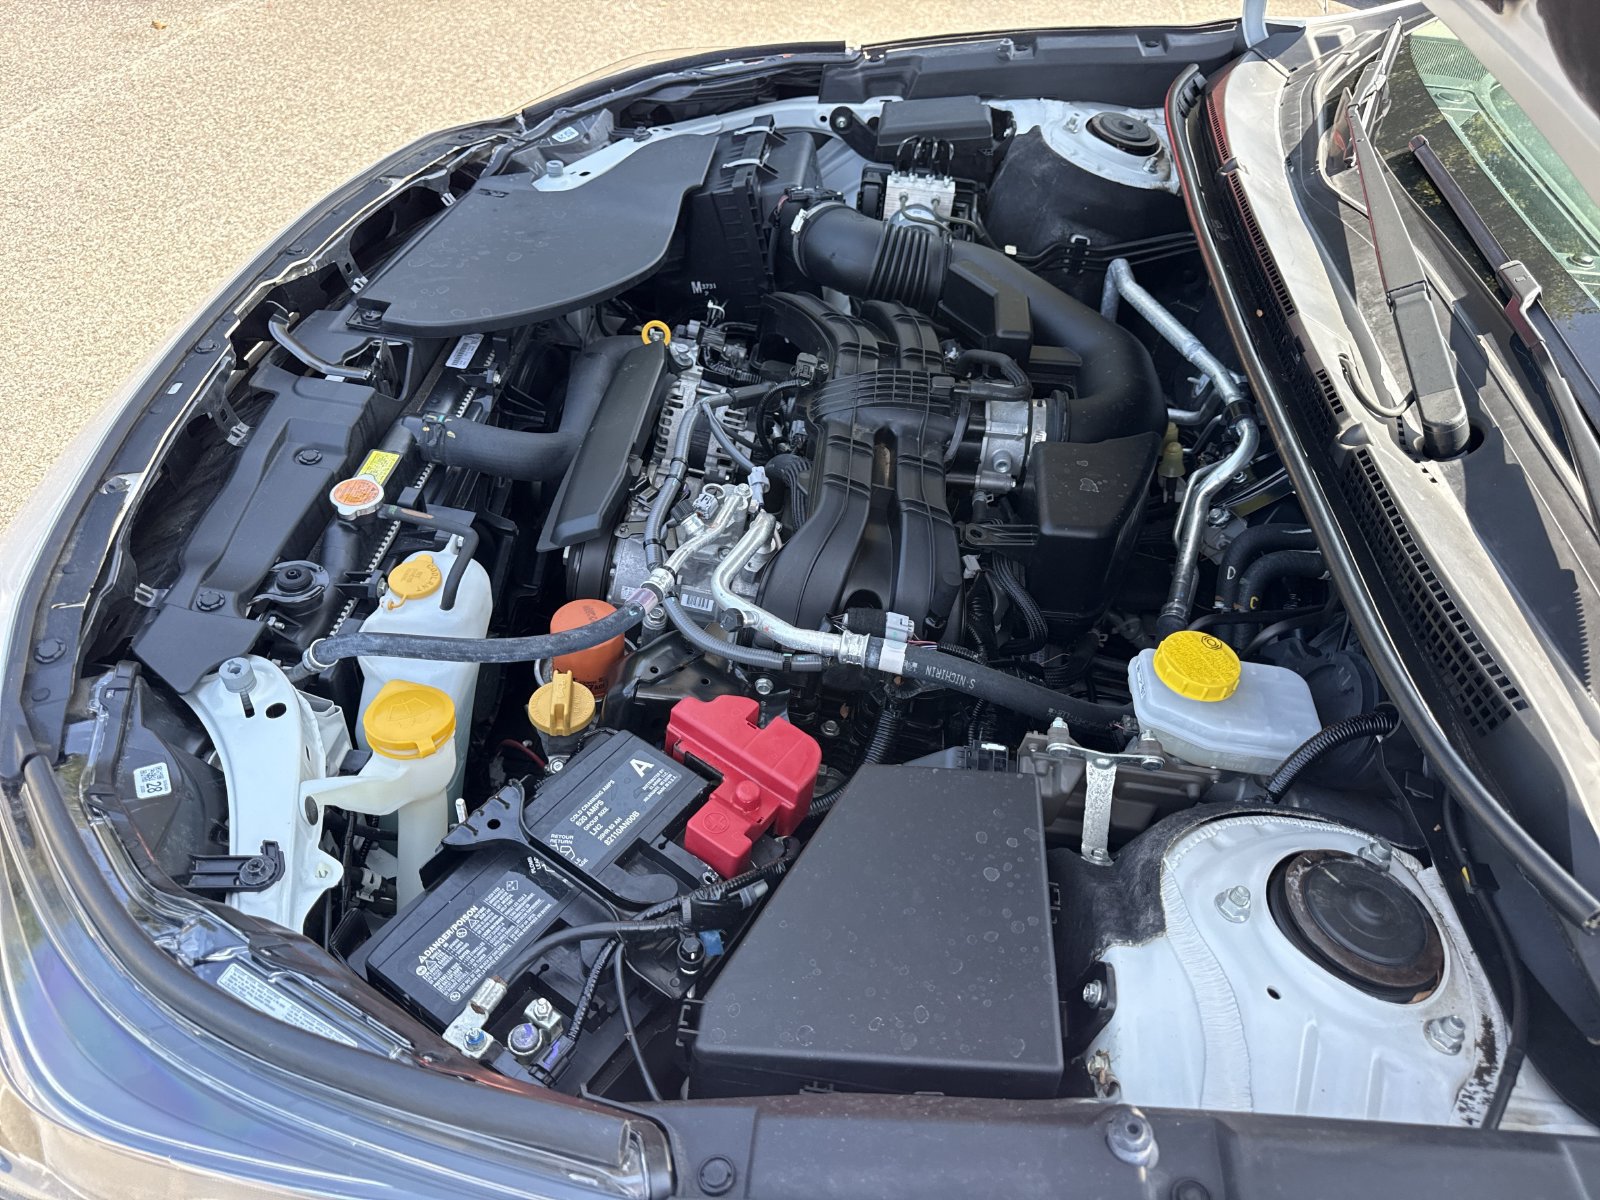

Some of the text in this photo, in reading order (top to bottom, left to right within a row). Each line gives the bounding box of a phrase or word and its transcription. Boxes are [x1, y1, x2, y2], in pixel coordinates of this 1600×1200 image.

[691, 281, 702, 294] M
[1227, 566, 1236, 580] D
[1250, 596, 1259, 610] C
[630, 759, 654, 777] A
[146, 781, 163, 794] 28
[570, 780, 615, 821] COLD CRANKING AMPS
[576, 800, 604, 826] 620 AMPS
[584, 816, 598, 830] GROUP
[614, 817, 622, 825] AH
[589, 824, 603, 836] LN2
[424, 905, 478, 957] DANGER/POISON
